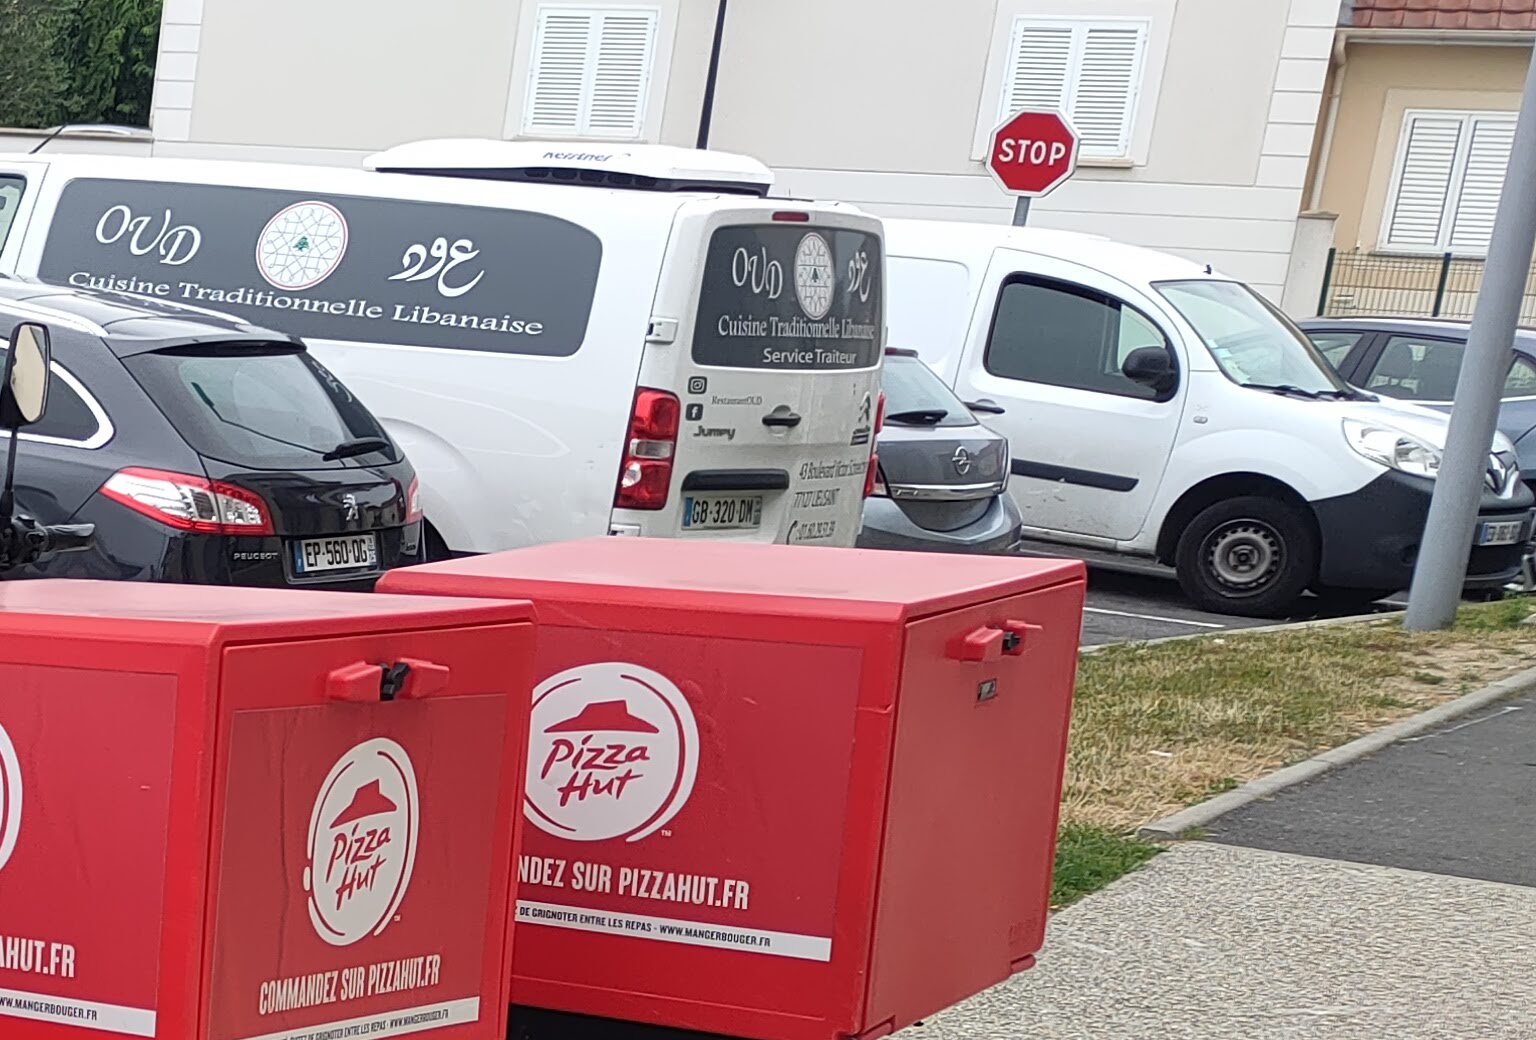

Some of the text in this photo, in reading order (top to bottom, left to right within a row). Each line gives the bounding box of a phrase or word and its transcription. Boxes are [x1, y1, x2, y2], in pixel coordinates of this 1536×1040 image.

[998, 138, 1066, 166] STOP
[94, 204, 202, 267] OUD
[387, 236, 486, 298] عود
[732, 246, 783, 299] OUD
[68, 271, 544, 336] Cuisine Traditionnelle Libanaise
[718, 314, 767, 336] Cuisine
[769, 317, 840, 339] Traditionnelle
[762, 347, 857, 365] Service Traiteur
[693, 425, 736, 441] Jumpy
[233, 552, 278, 560] PEUGEOT
[540, 734, 650, 780] Pizza
[557, 768, 643, 807] Hut
[326, 822, 391, 884] Pizza
[335, 854, 387, 911] Hut
[571, 861, 612, 893] SUR
[618, 867, 750, 910] PIZZAHUT.FR
[519, 906, 530, 916] DE
[532, 908, 577, 923] GRIGNOTER
[579, 913, 606, 926] ENTRE
[608, 918, 623, 928] LES
[625, 920, 652, 932] REPAS
[659, 924, 771, 947] WWW.MANGERBOUGER.FR
[259, 954, 441, 1015] COMMANDEZ SUR PIZZAHUT.FR
[344, 1025, 360, 1038] ENTRE
[360, 1023, 369, 1035] LES
[371, 1020, 386, 1033] REPAS
